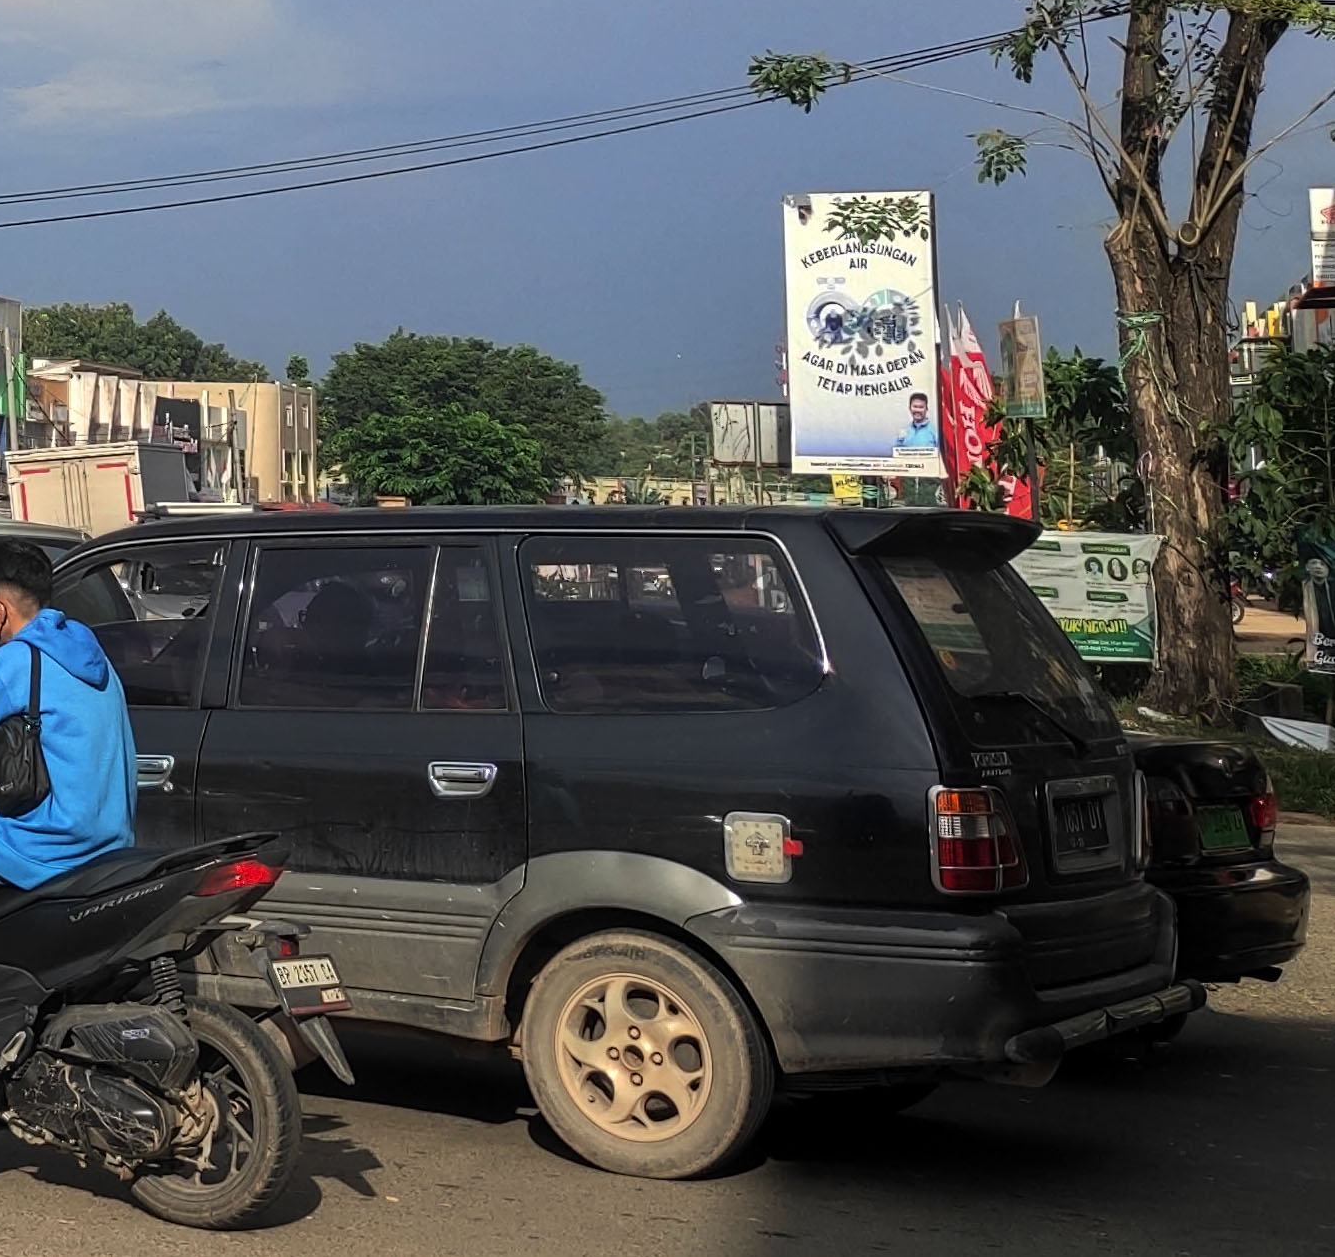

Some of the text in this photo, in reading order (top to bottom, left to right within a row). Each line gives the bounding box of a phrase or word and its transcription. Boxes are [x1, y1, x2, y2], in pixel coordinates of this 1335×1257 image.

[800, 242, 917, 269] KEBERLANGSUNGAN
[849, 258, 868, 270] AIR
[801, 348, 926, 377] AGAR DI MASA DEPAN
[816, 375, 913, 397] TETAP MENGALIR
